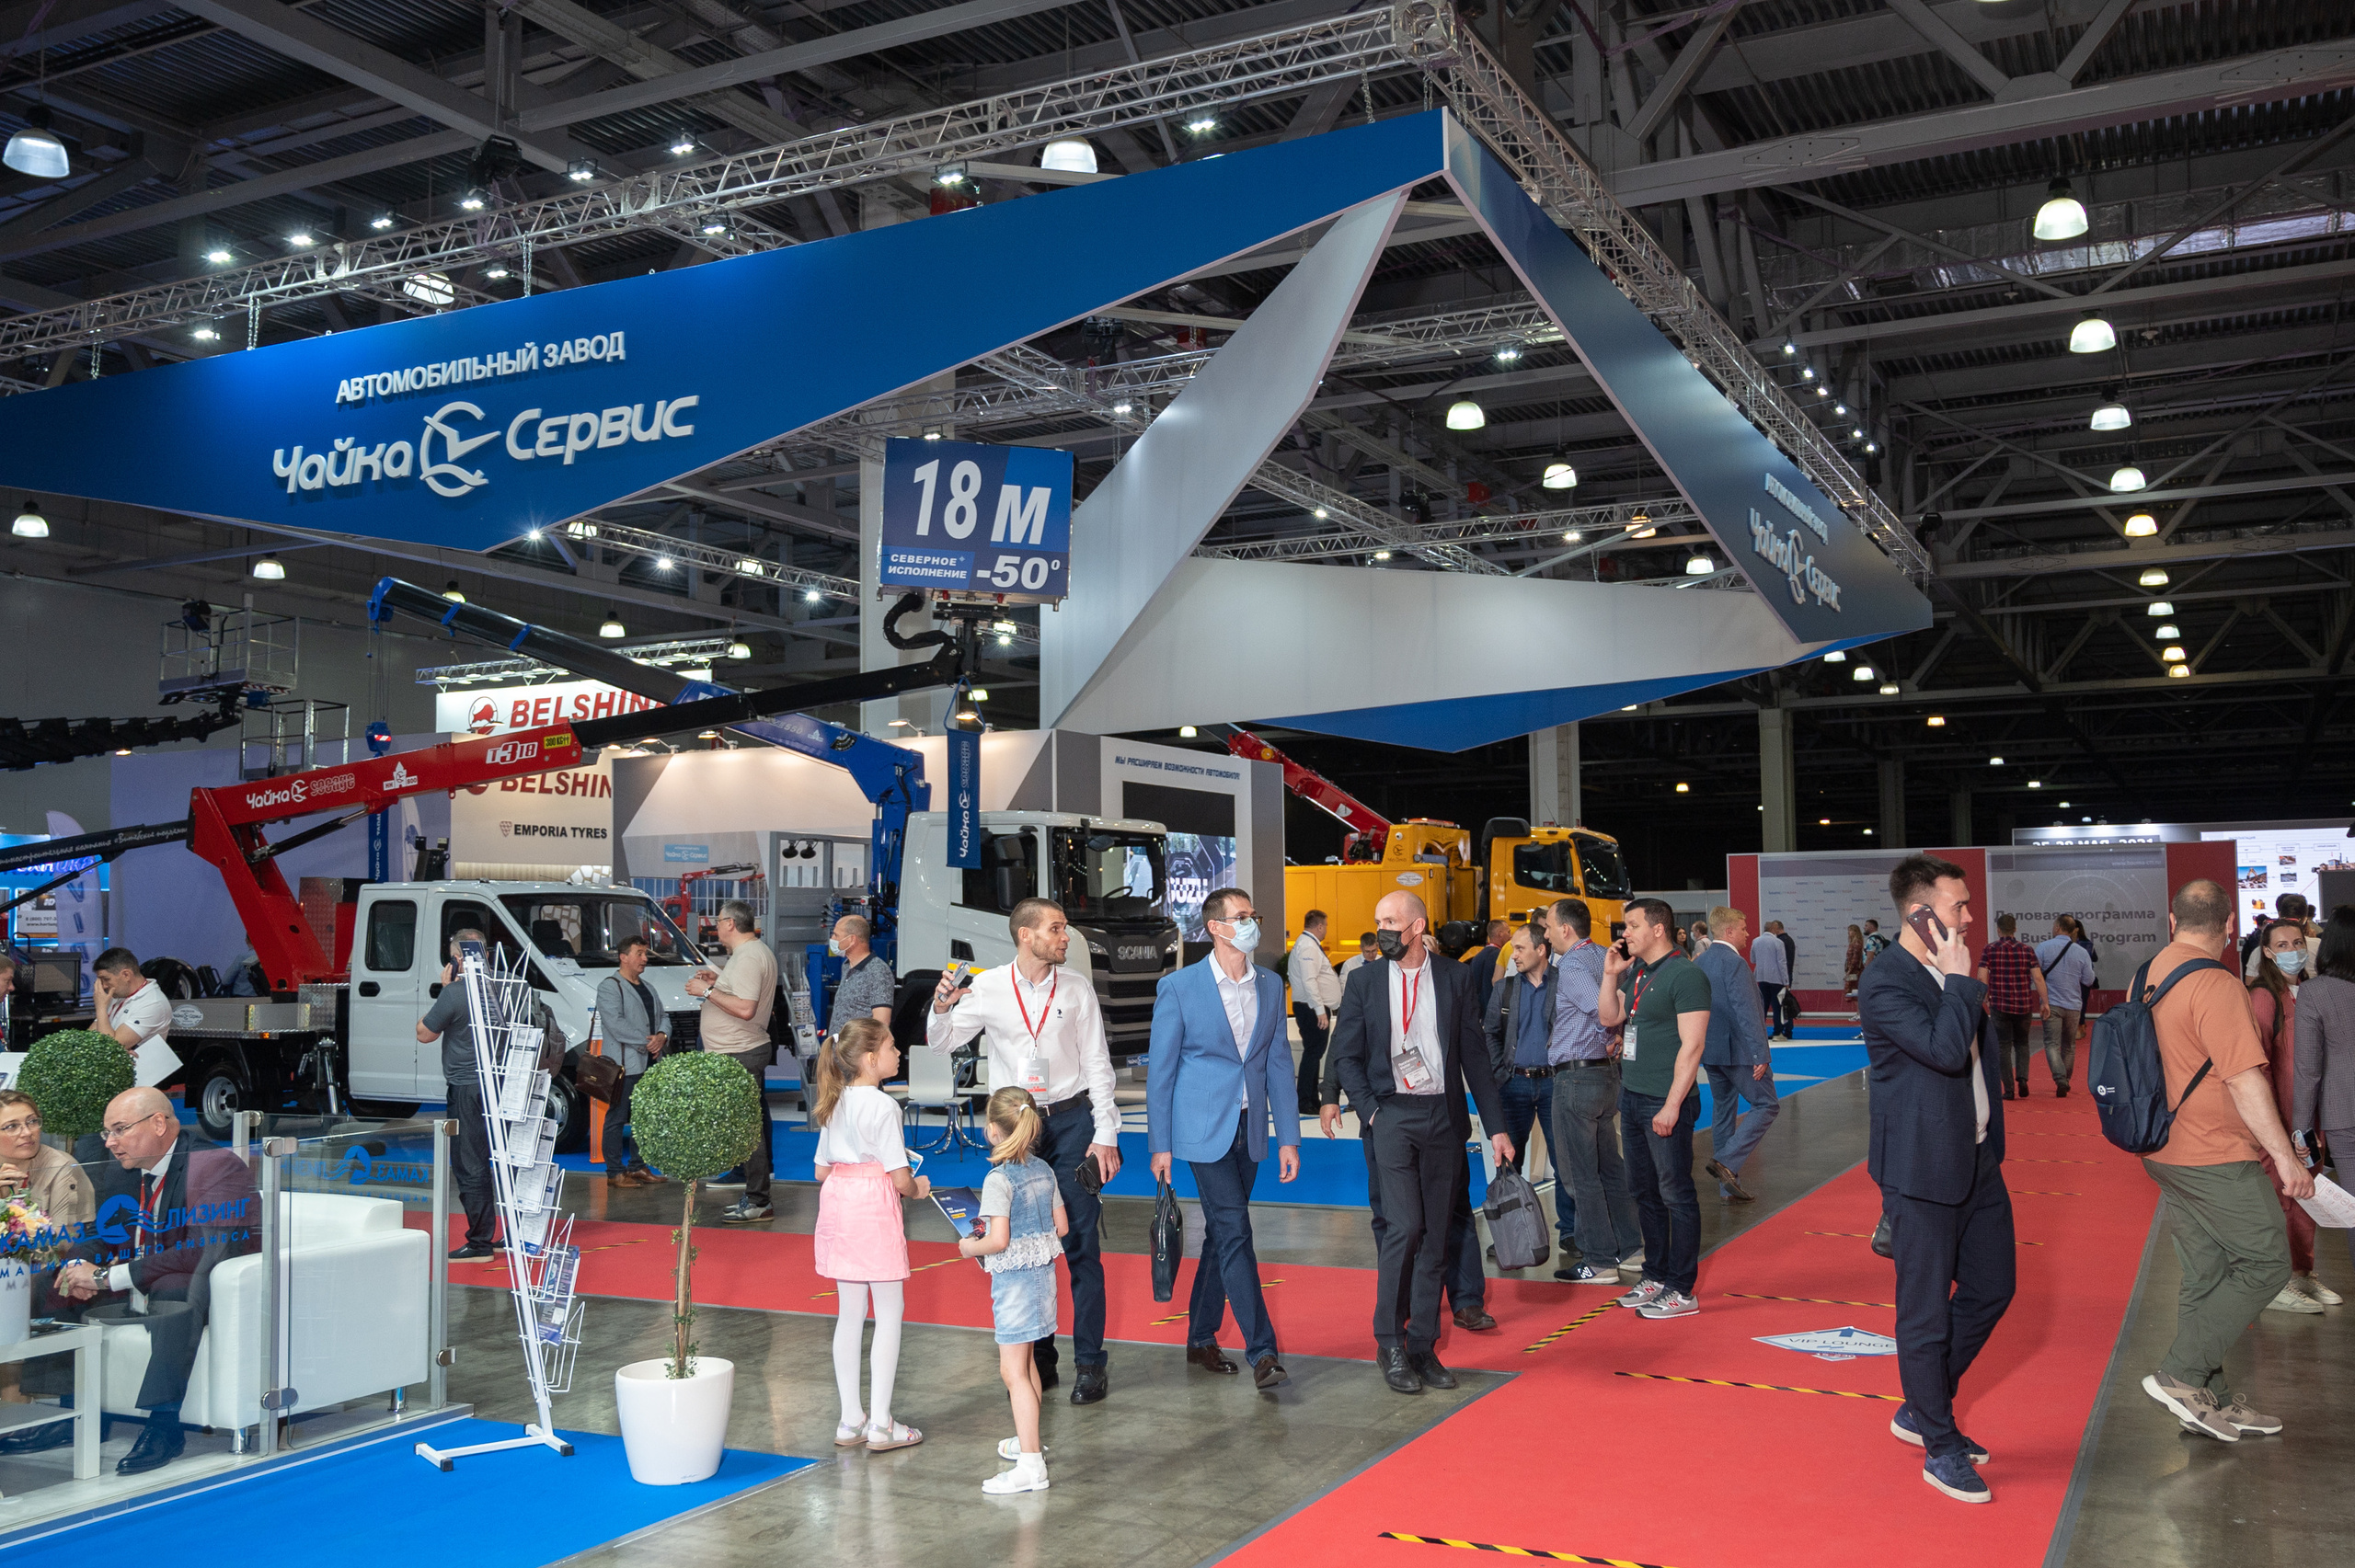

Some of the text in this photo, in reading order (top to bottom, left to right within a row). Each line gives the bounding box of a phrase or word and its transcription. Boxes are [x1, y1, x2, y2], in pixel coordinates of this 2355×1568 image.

[336, 331, 626, 404] АВТОМОБИЛЬНЫЙ ЗАВОД
[272, 395, 700, 493] Чайка Сервис
[913, 459, 982, 540] 18
[888, 566, 967, 579] ИСПОЛНЕНИЕ
[890, 554, 957, 567] СЕВЕРНОЕ
[510, 690, 668, 728] BELSHIN
[1115, 756, 1126, 765] МЫ
[1127, 757, 1163, 770] РАСШИРЯЕМ
[246, 789, 290, 809] Чайка
[513, 824, 608, 840] EMPORIA TYRES
[959, 811, 971, 858] Чайка
[2090, 932, 2156, 945] Program
[1117, 945, 1158, 960] SCANIA
[0, 1198, 250, 1253] КАМАЗ ЛИЗИНГ
[95, 1244, 165, 1265] ВАШЕГО
[176, 1230, 250, 1251] БИЗНЕСА
